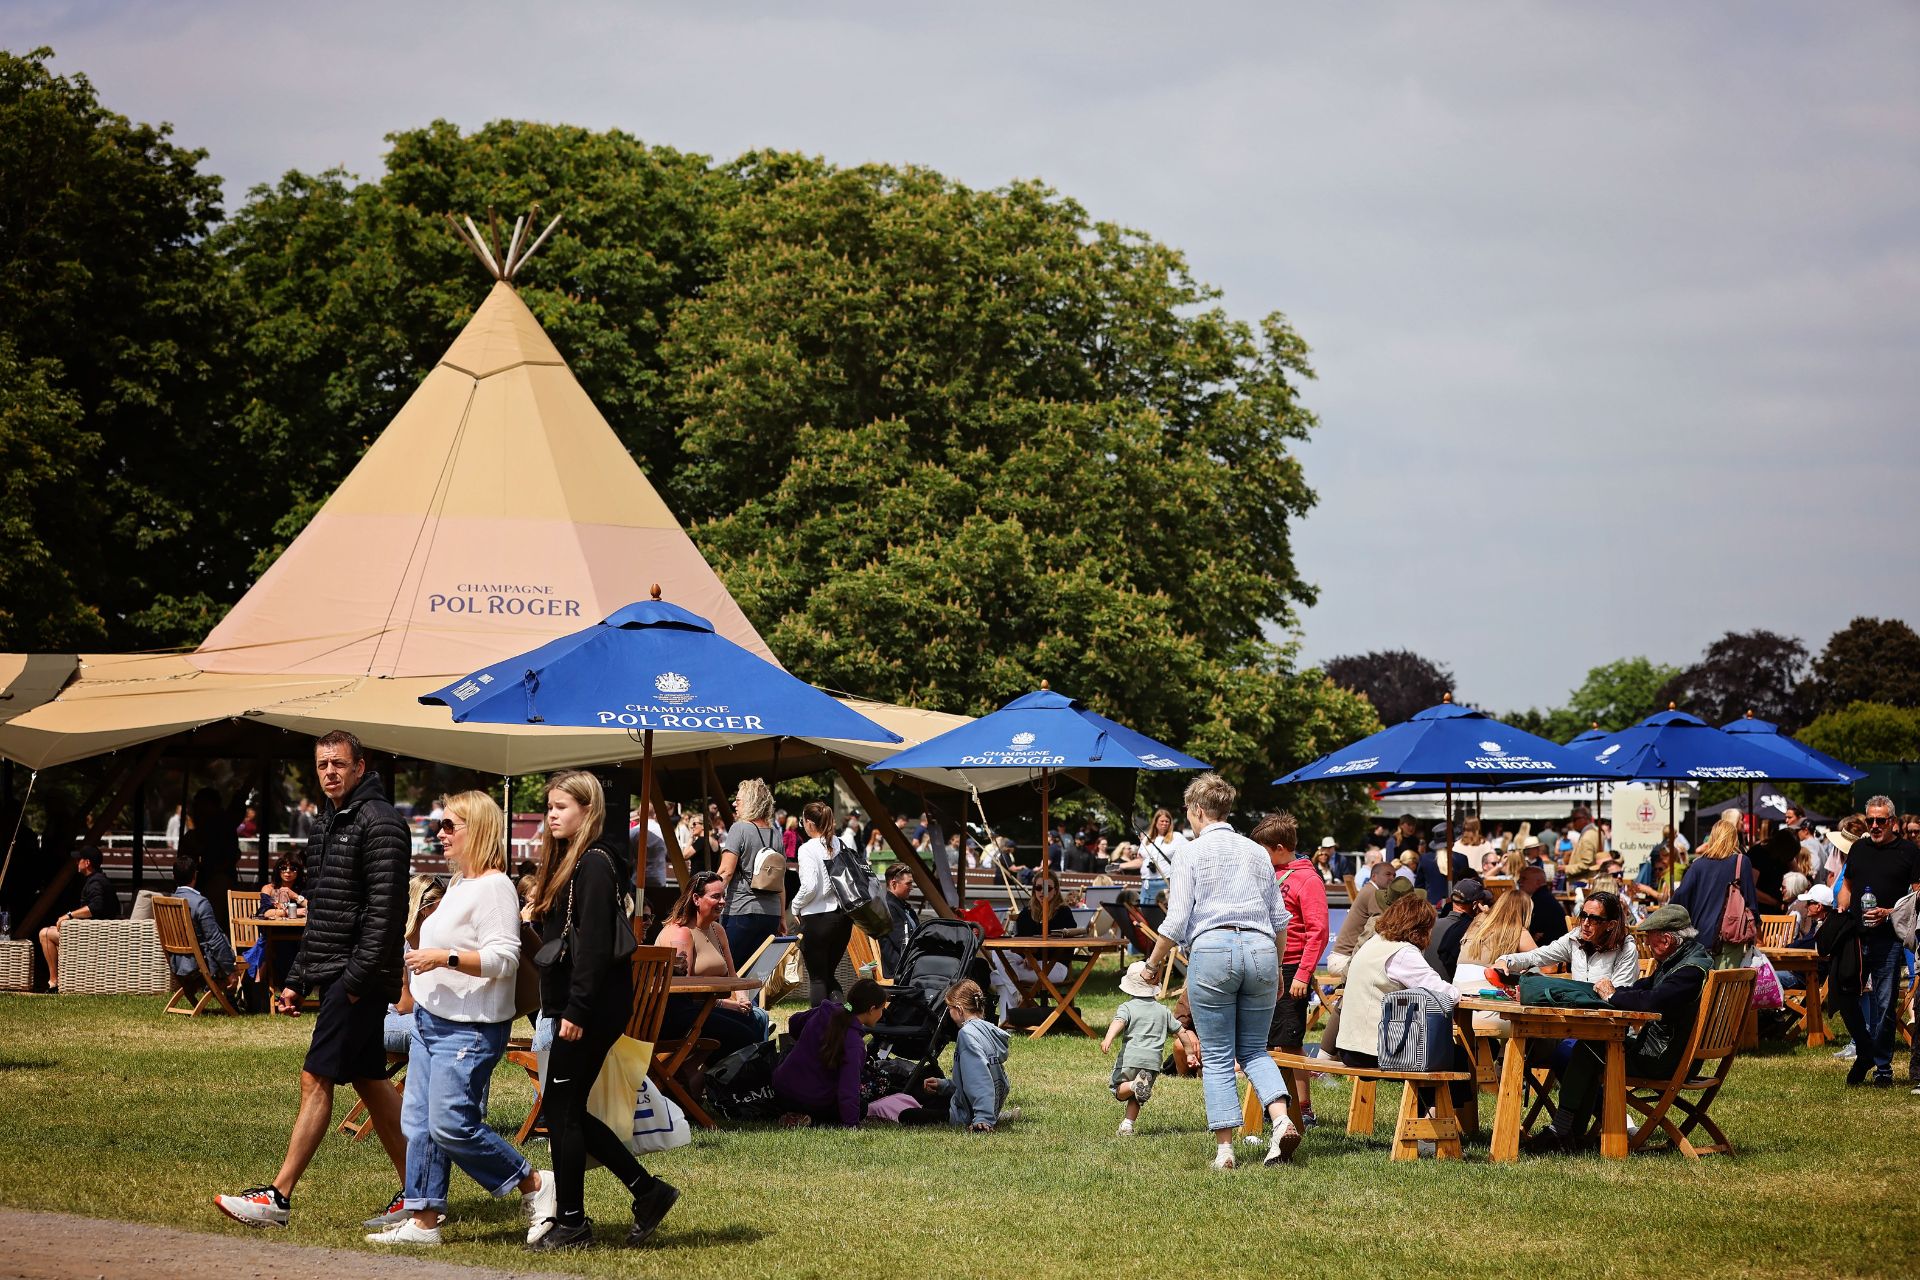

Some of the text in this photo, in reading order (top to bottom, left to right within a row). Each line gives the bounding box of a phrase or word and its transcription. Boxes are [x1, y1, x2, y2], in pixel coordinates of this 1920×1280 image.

[457, 584, 554, 594] CHAMPAGNE
[428, 594, 581, 617] POL ROGER
[625, 704, 730, 714] CHAMPAGNE
[597, 711, 765, 730] POL ROGER
[960, 756, 1065, 765] POL ROGER
[1465, 761, 1557, 769] POL ROGER
[1716, 770, 1769, 778] ROGER
[1619, 842, 1637, 850] Club
